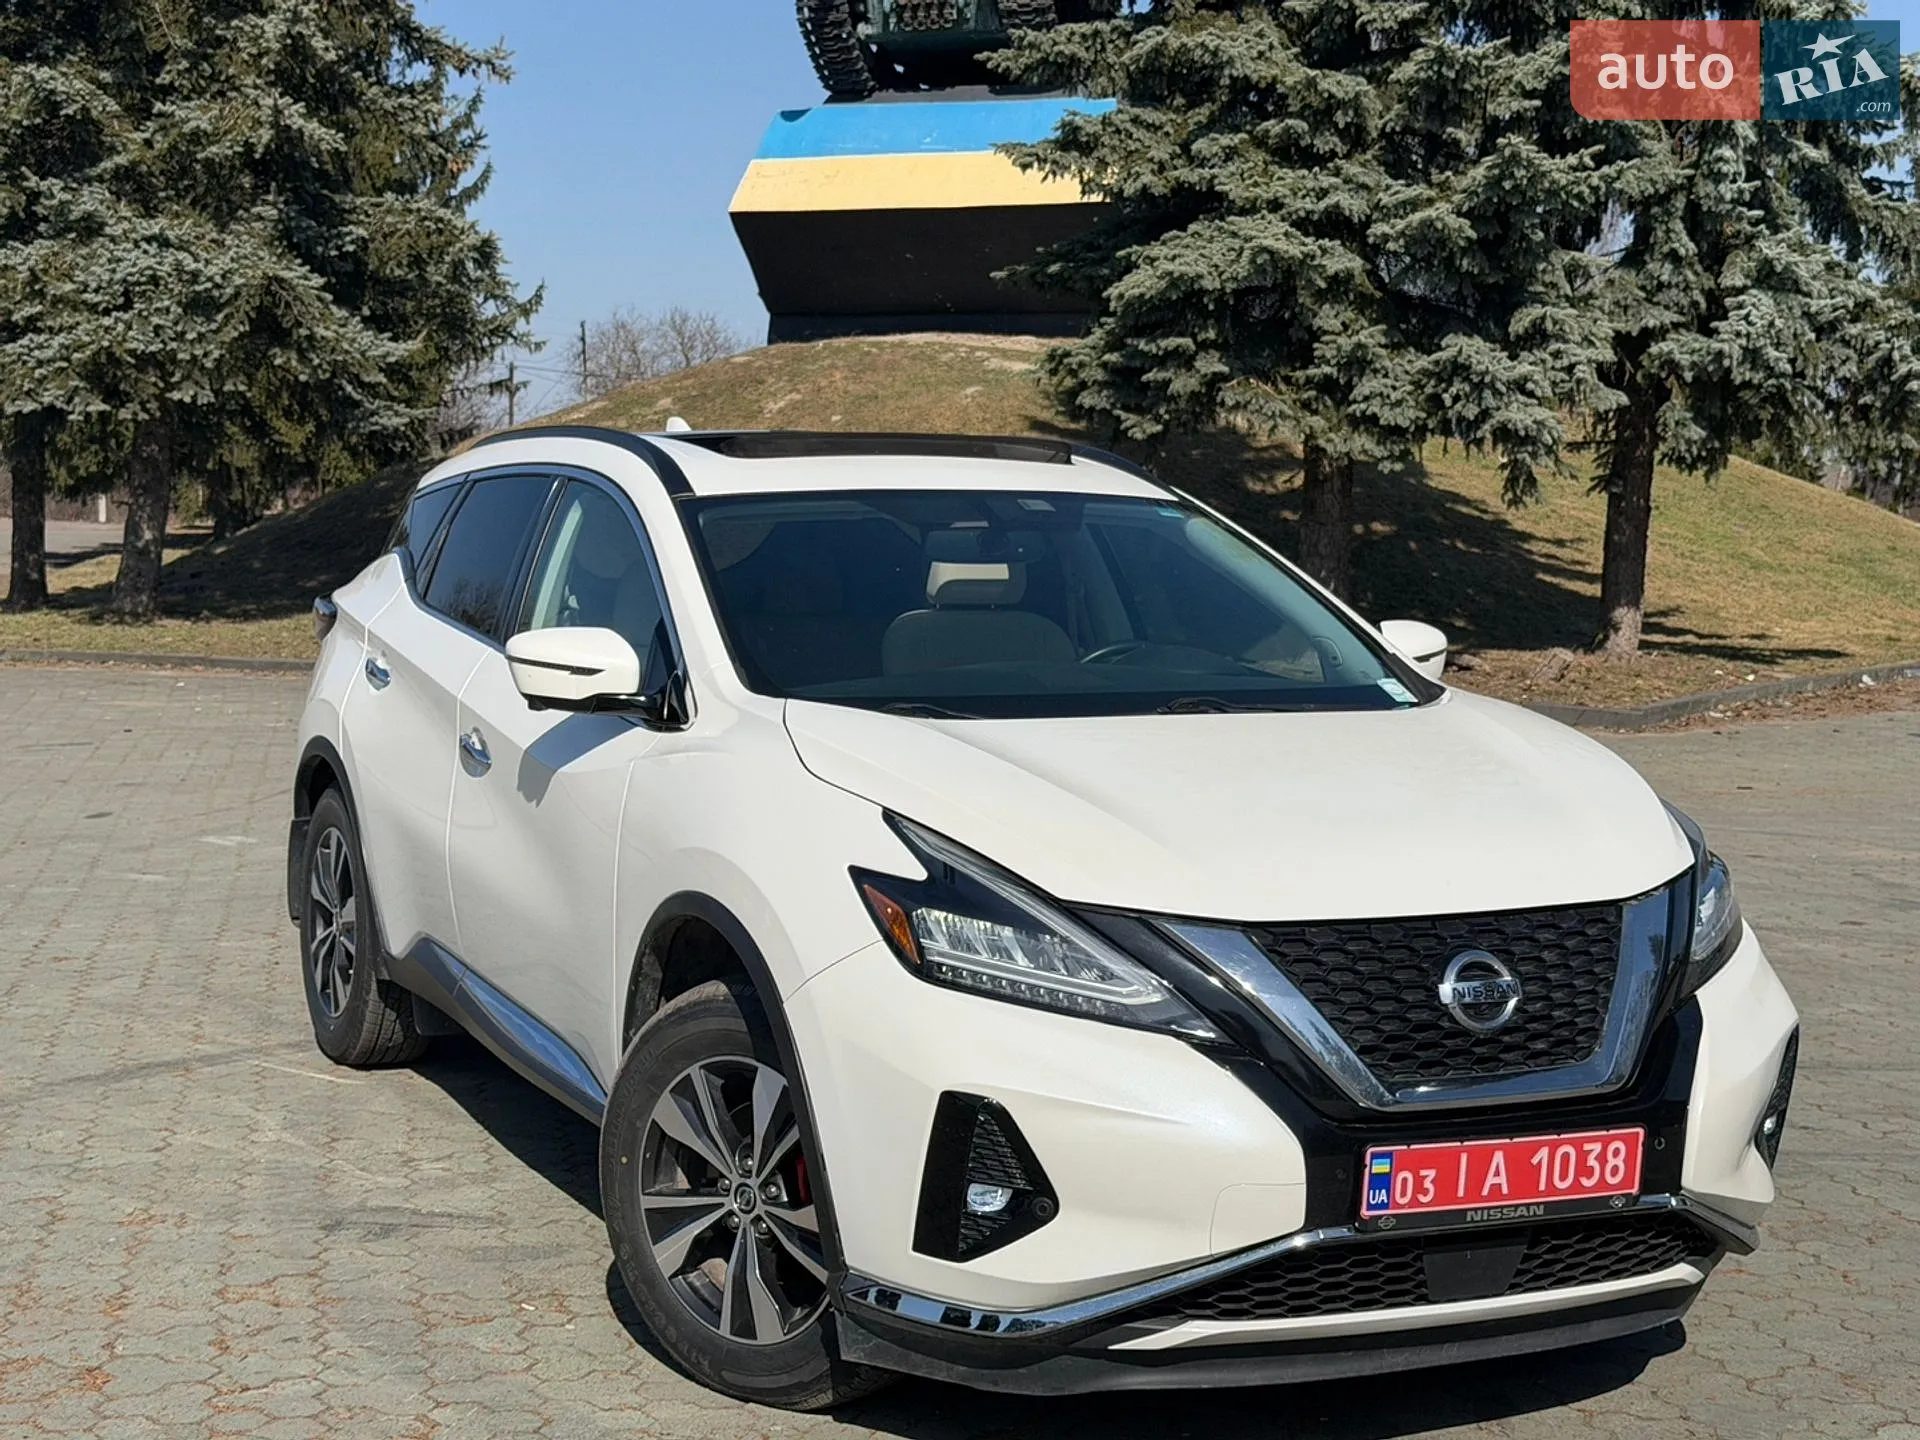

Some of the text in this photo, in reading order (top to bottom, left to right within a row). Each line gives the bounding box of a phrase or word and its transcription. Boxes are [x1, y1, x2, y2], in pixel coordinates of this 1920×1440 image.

[1452, 983, 1517, 1000] NISSAN
[1394, 1168, 1437, 1205] 03
[1530, 1140, 1627, 1192] 1038
[1369, 1189, 1388, 1204] UA
[1466, 1205, 1545, 1222] NISSAN
